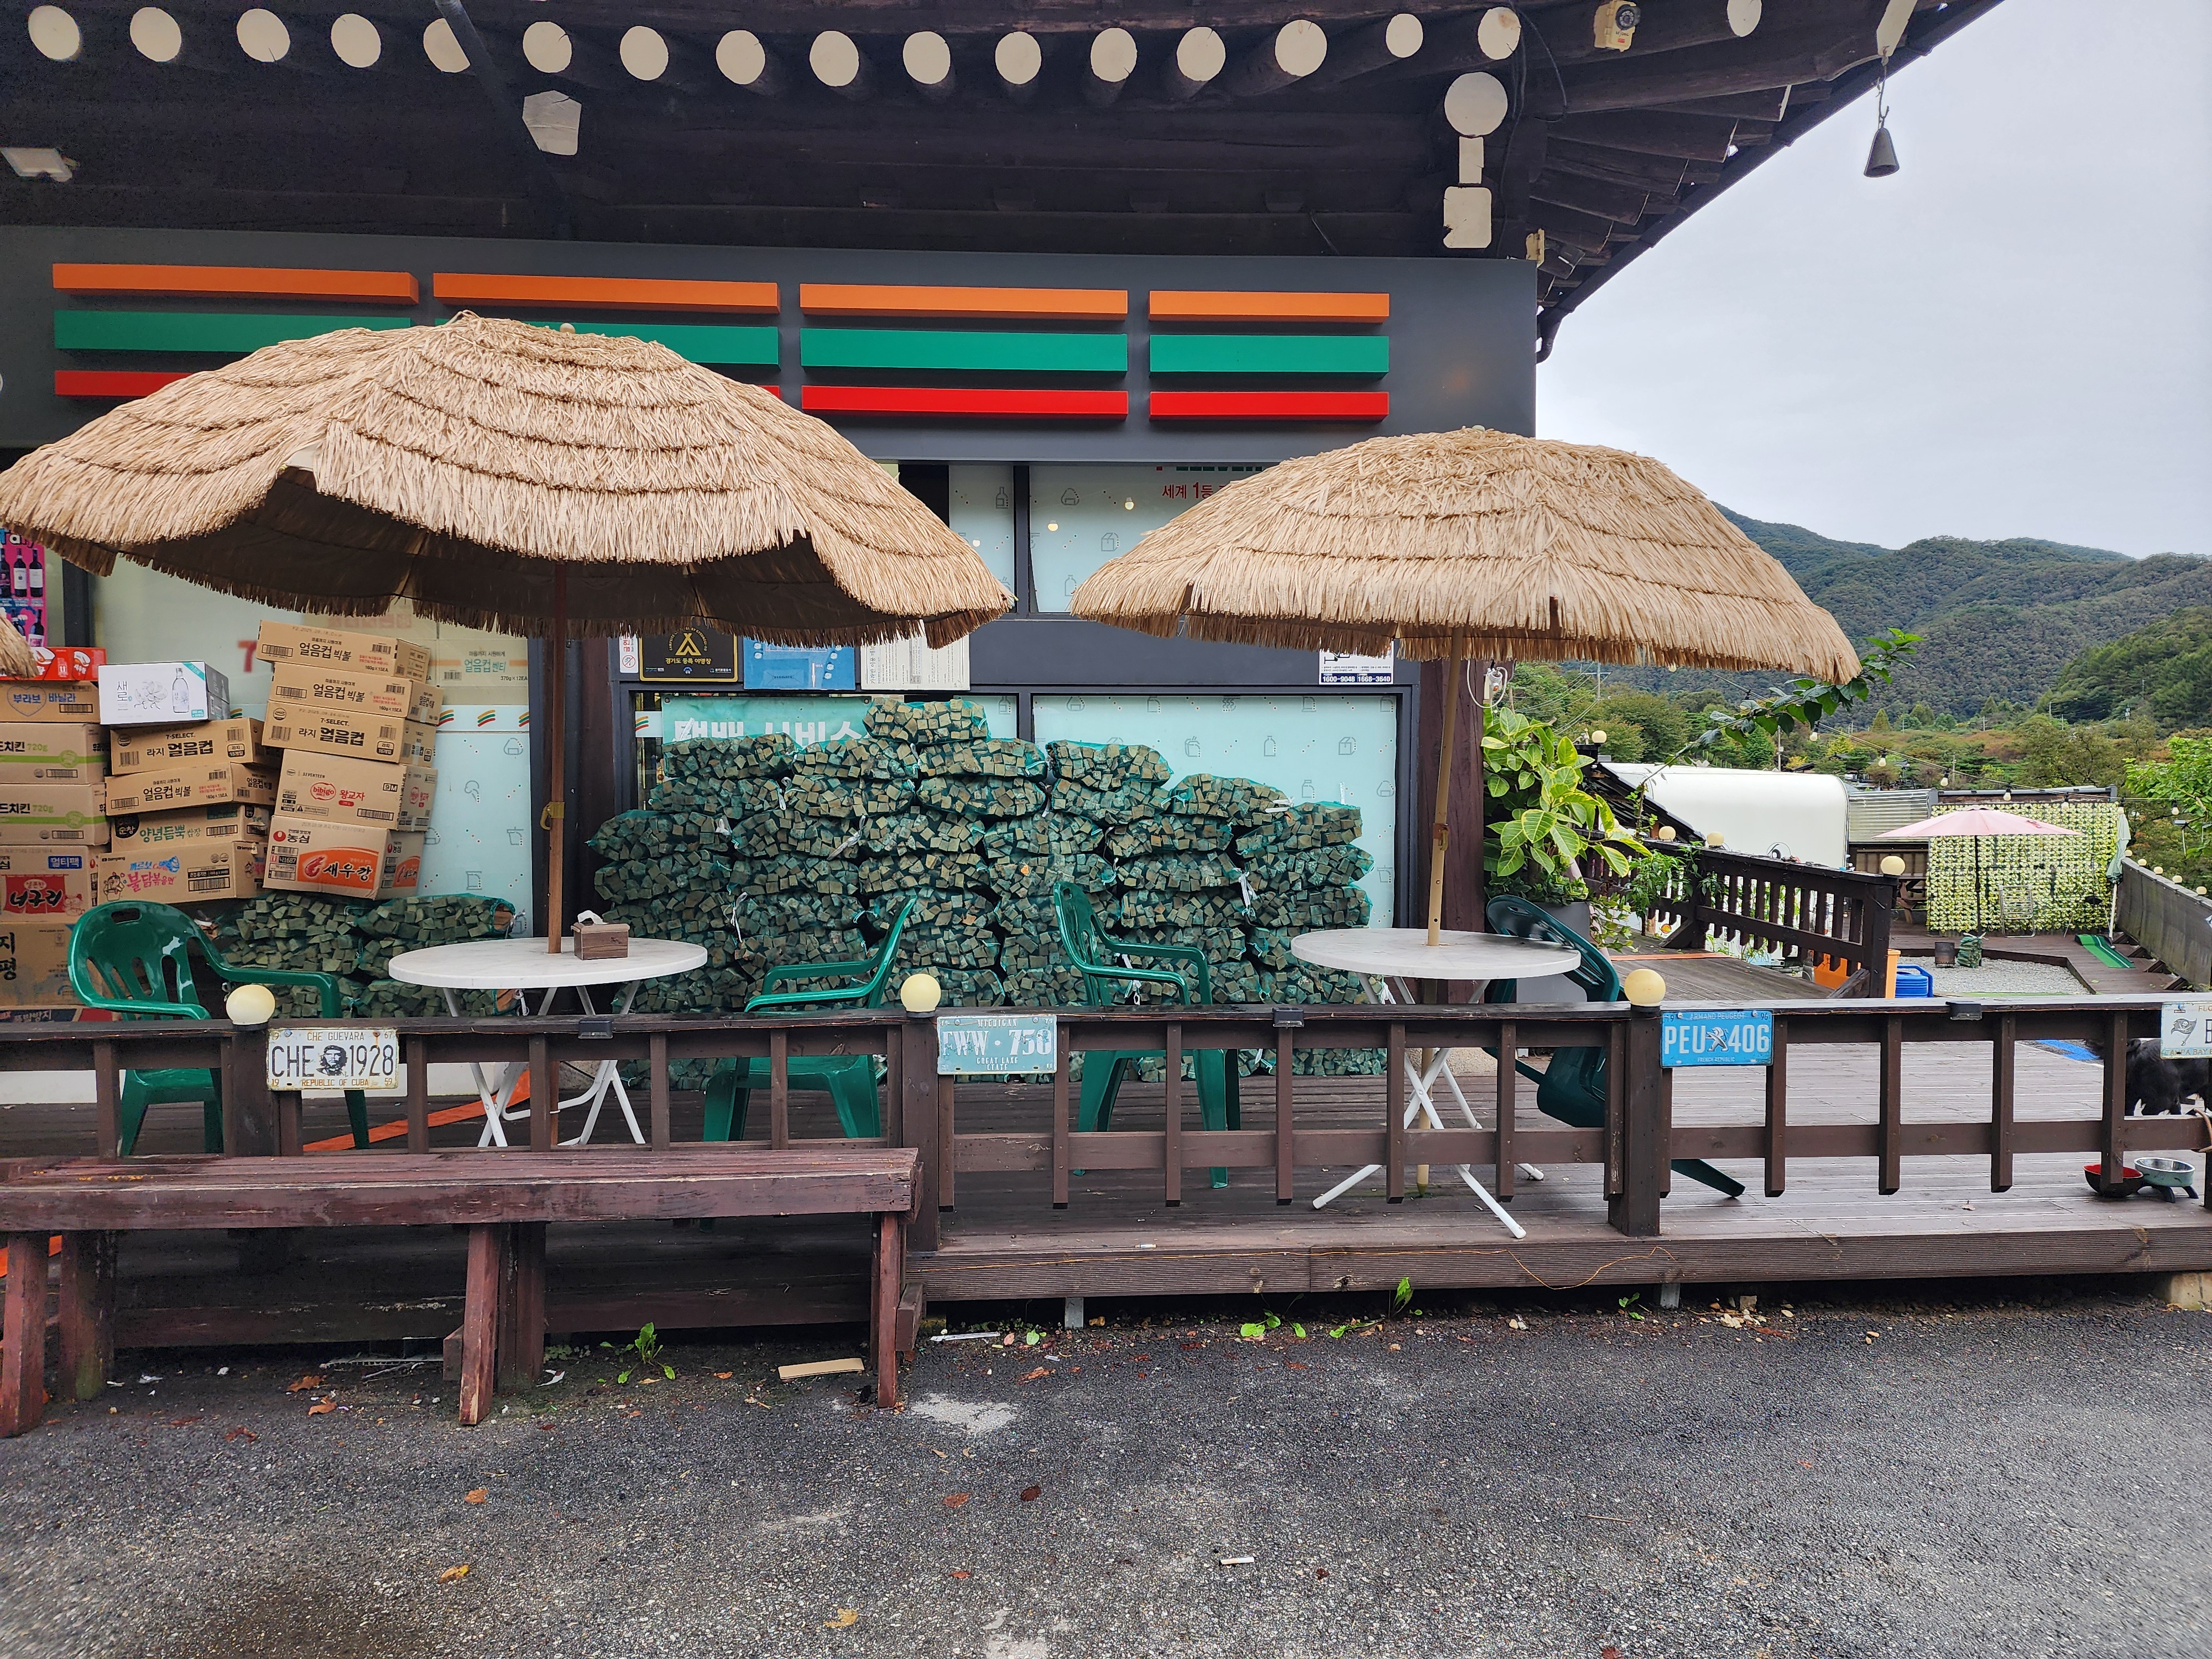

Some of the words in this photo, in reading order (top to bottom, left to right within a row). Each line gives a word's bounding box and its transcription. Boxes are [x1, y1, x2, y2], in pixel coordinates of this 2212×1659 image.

[1162, 484, 1187, 499] 세계
[1193, 482, 1213, 499] 1등
[299, 642, 332, 659] 얼음컵
[333, 649, 352, 662] 빅볼
[623, 639, 630, 652] 금연
[465, 659, 491, 672] 얼음컵
[13, 693, 41, 703] 부라보
[49, 692, 77, 703] 바닐라
[117, 681, 128, 701] 새로
[314, 684, 346, 700] 얼음컵
[347, 691, 365, 702] 빅볼
[299, 728, 316, 738] 라지
[320, 727, 365, 747] 얼음컵
[27, 743, 48, 752] 720g
[147, 748, 165, 757] 라지
[168, 740, 213, 757] 얼음컵
[247, 777, 263, 789] 얼음컵
[313, 786, 335, 796] bibigo
[143, 785, 174, 801] 얼음컵
[175, 785, 191, 797] 빅볼
[339, 789, 366, 801] 왕교자
[32, 804, 54, 813] 720g
[139, 824, 186, 843] 양념듬뿍
[287, 833, 310, 844] 농심
[50, 857, 79, 868] 멀티팩
[323, 862, 372, 881] 새우깡
[127, 871, 176, 893] 불닭볶음면
[10, 889, 62, 907] 너구리
[307, 1032, 323, 1041] CHE
[328, 1032, 365, 1041] GUEVARA
[1664, 1025, 1706, 1055] PEU
[1728, 1024, 1770, 1053] 406
[272, 1045, 315, 1077] CHE
[349, 1045, 394, 1077] 1928
[271, 1079, 279, 1088] 19
